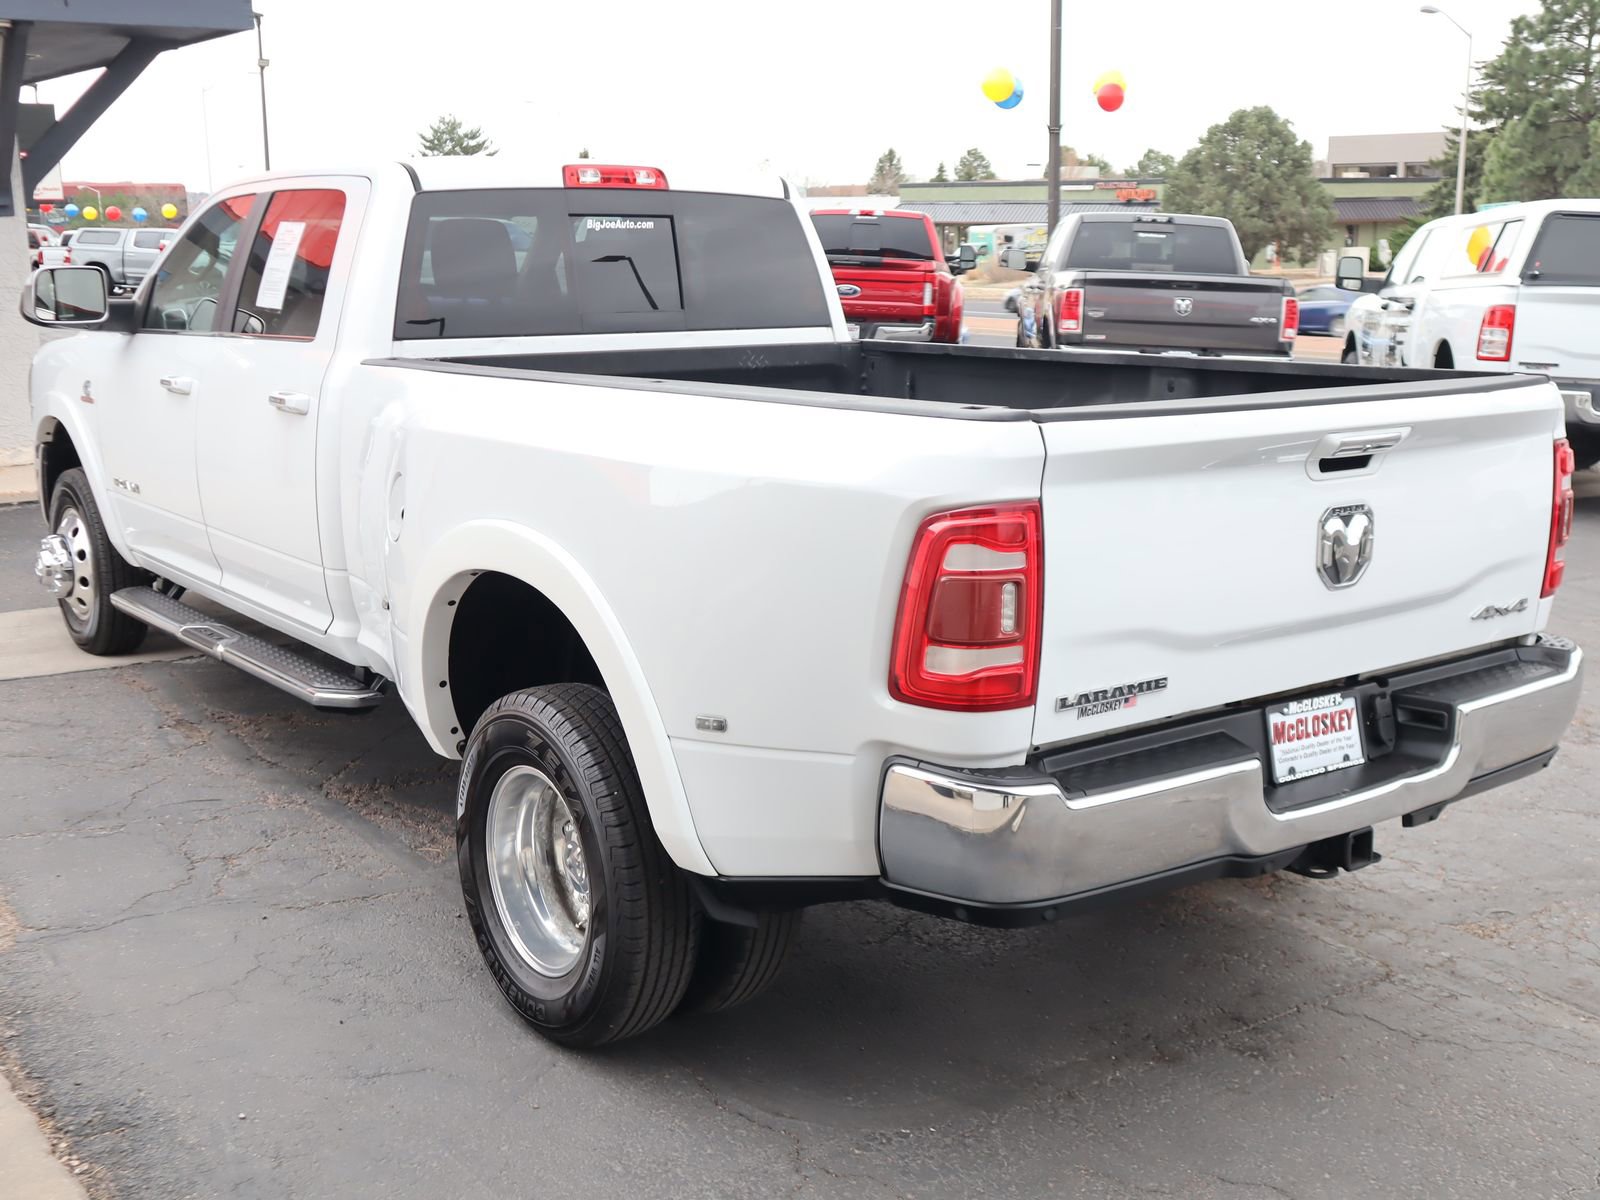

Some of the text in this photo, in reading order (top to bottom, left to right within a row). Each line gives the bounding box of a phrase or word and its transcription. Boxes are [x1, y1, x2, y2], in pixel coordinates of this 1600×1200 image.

[586, 219, 654, 231] BigJoeAuto.com
[1332, 504, 1366, 516] RAM
[1055, 676, 1168, 712] LARAMIE
[1289, 693, 1343, 714] McCLOSKEY
[1079, 699, 1123, 718] McCLOSKEY
[1272, 708, 1355, 745] McCLOSKEY
[1279, 758, 1365, 783] COLORADO SPRINGS
